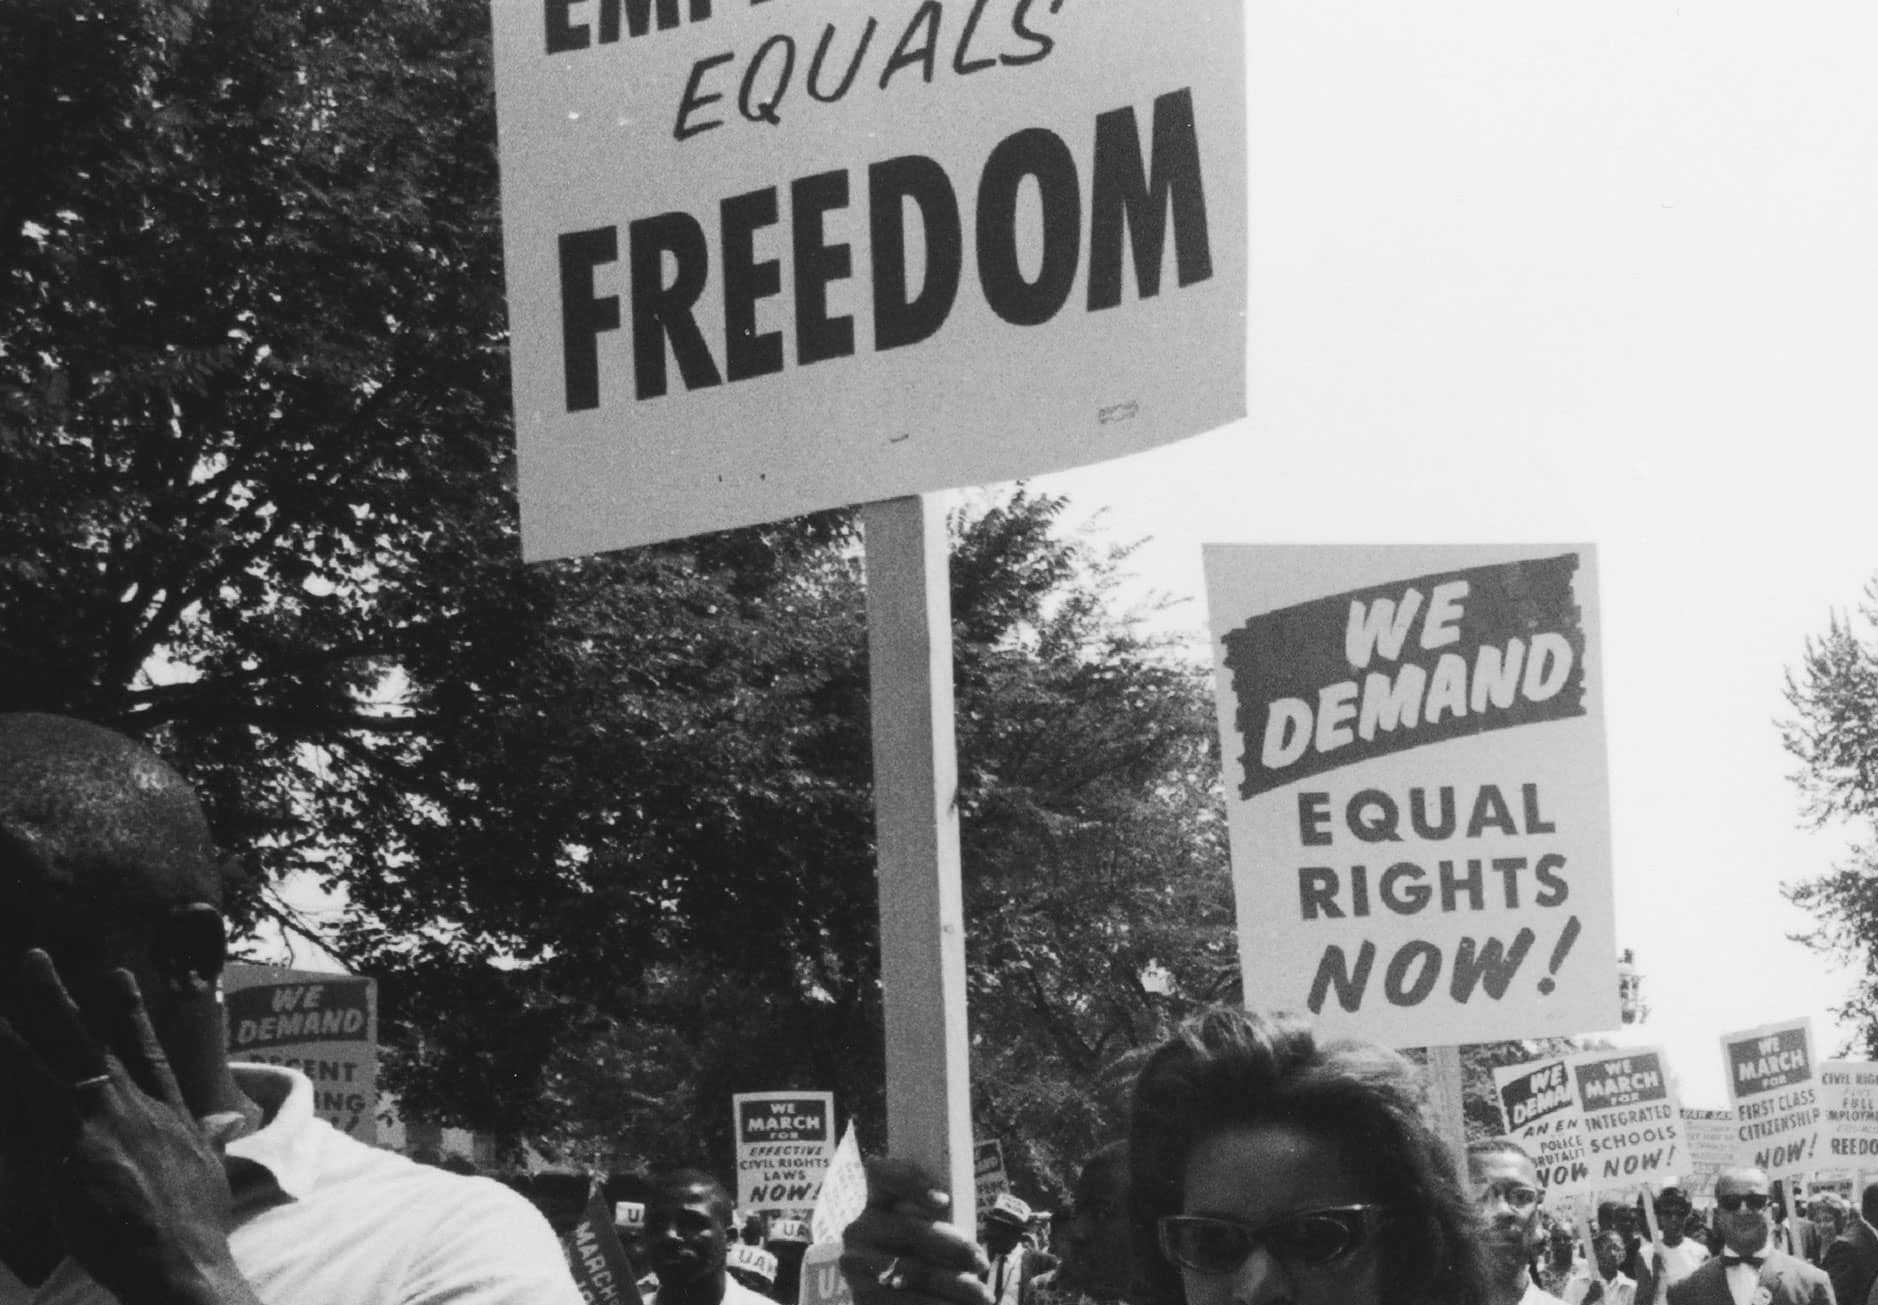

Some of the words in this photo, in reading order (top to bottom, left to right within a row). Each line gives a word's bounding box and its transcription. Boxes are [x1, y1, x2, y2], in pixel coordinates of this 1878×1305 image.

[673, 0, 1064, 141] EQUALS
[558, 86, 1213, 414] FREEDOM
[1345, 580, 1470, 669] WE
[1262, 632, 1573, 769] DEMAND
[1298, 783, 1556, 847] EQUAL
[1298, 853, 1570, 920] RIGHTS
[1307, 915, 1582, 1015] NOW!
[272, 985, 324, 1012] WE
[237, 1008, 365, 1045] DEMAND
[1757, 1037, 1781, 1056] WE
[1530, 1064, 1563, 1094] WE
[1604, 1059, 1633, 1075] WE
[1738, 1049, 1805, 1082] MARCH
[1822, 1072, 1851, 1086] CIVIL
[1585, 1071, 1659, 1099] MARCH
[1761, 1074, 1788, 1089] FOR
[770, 1103, 796, 1114] WE
[1512, 1084, 1572, 1125] DEMA
[1585, 1104, 1672, 1132] INTEGRATED
[1738, 1098, 1776, 1122] FIRST
[1778, 1088, 1817, 1112] CLASS
[1842, 1098, 1874, 1111] FULL
[747, 1116, 821, 1132] MARCH
[770, 1131, 799, 1140] FOR
[1523, 1122, 1549, 1139] AN
[1555, 1119, 1579, 1132] EN
[1738, 1107, 1821, 1142] CITIZENSHIP
[750, 1145, 822, 1157] EFFECTIVE
[1540, 1135, 1584, 1153] POLICE
[1590, 1126, 1677, 1154] SCHOOLS
[1754, 1132, 1818, 1170] NOW!
[739, 1159, 776, 1170] CIVIL
[778, 1157, 830, 1169] RIGHTS
[764, 1170, 807, 1181] LAWS
[1603, 1145, 1677, 1178] NOW!
[750, 1181, 823, 1202] NOW!
[576, 1221, 620, 1302] MARCH
